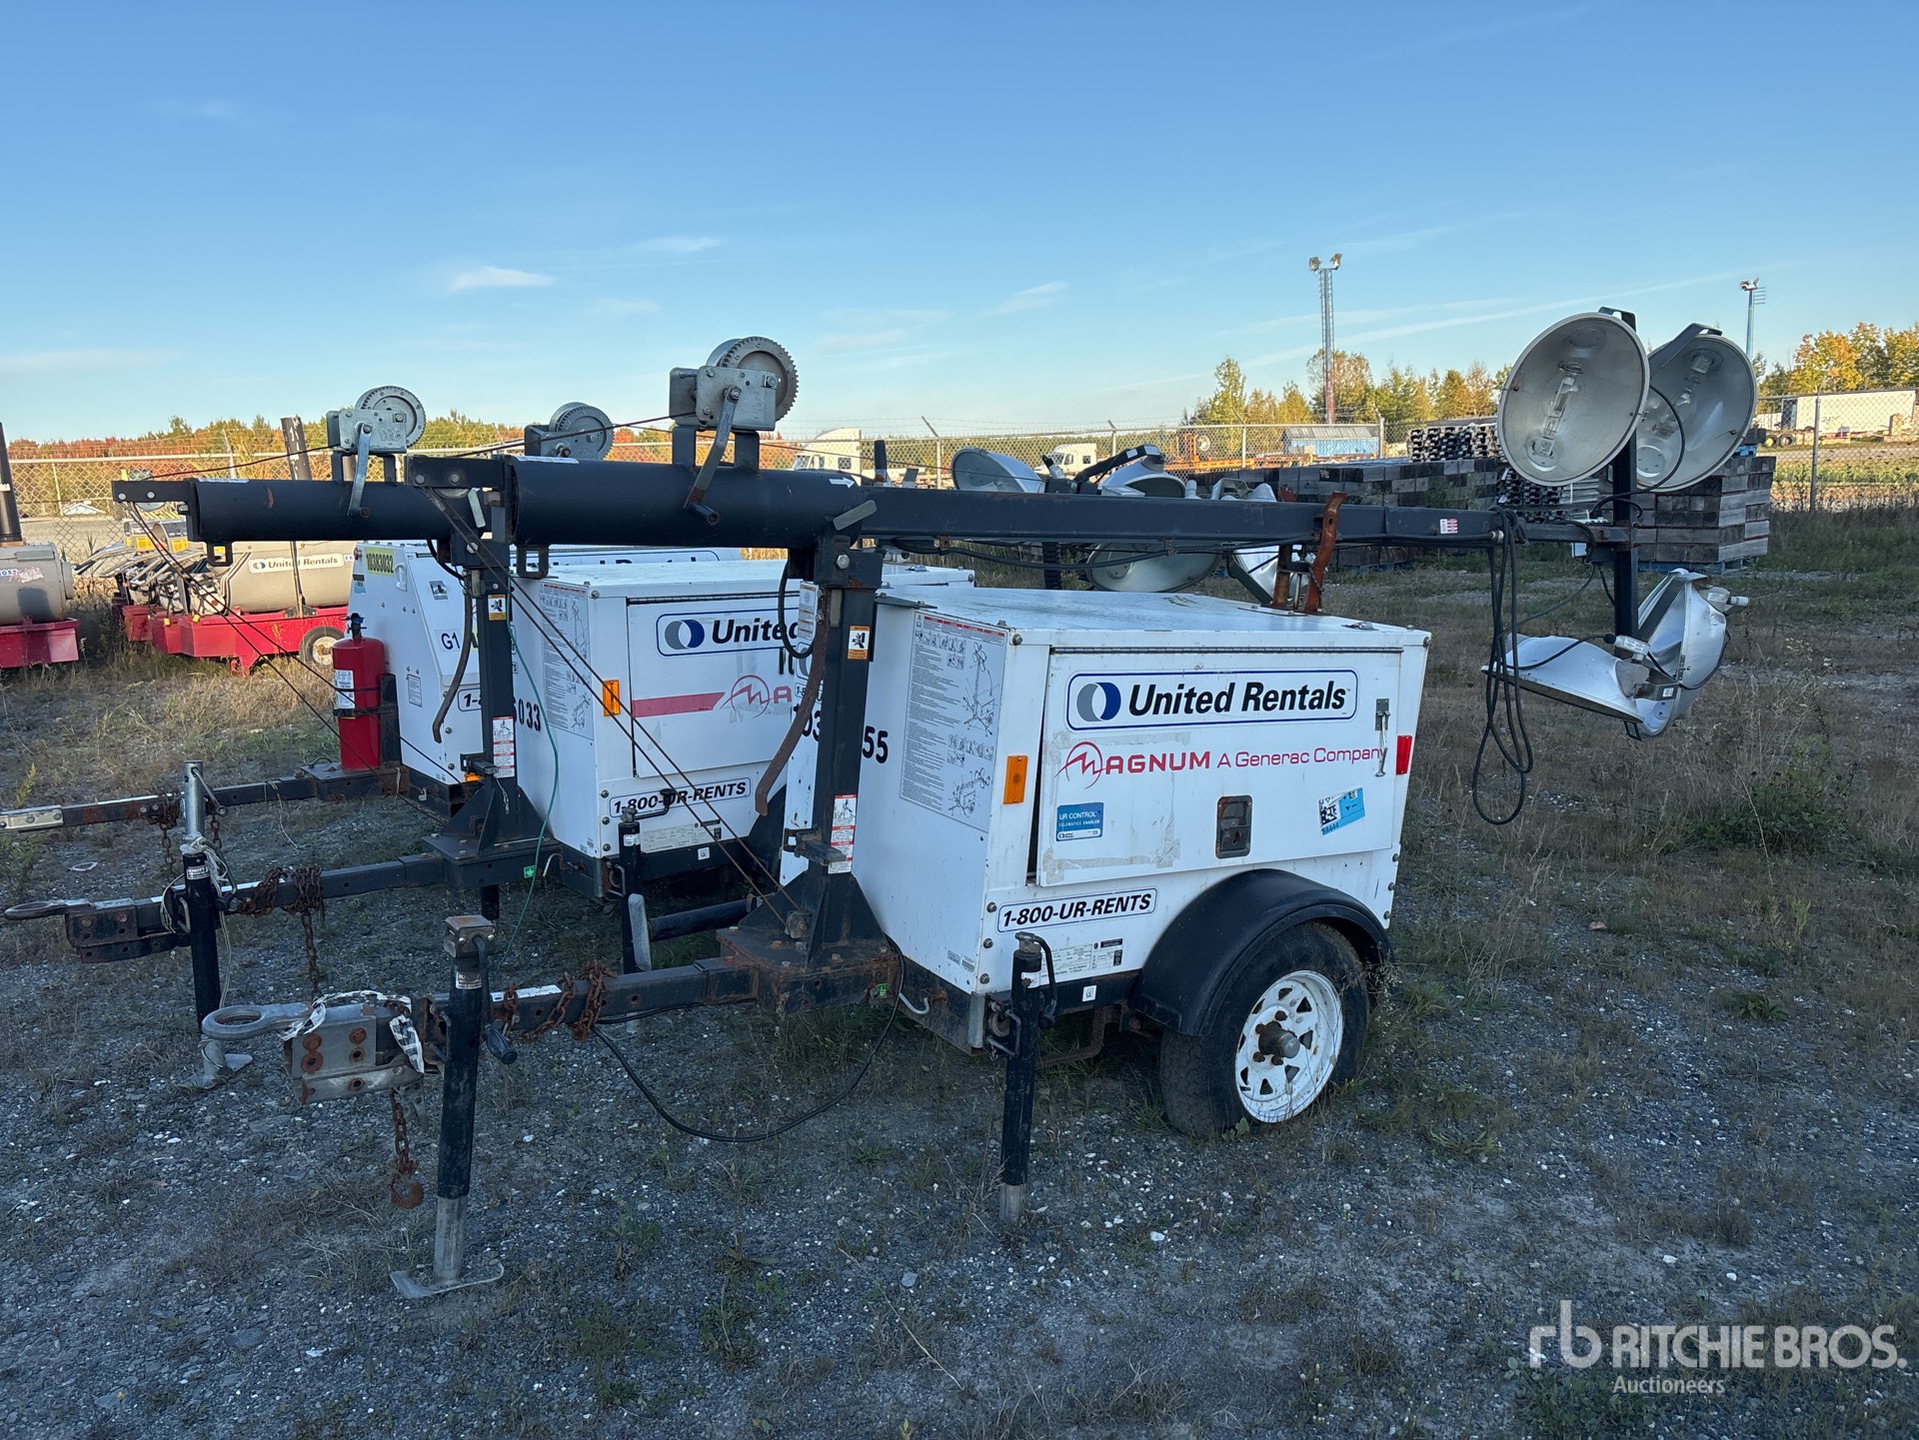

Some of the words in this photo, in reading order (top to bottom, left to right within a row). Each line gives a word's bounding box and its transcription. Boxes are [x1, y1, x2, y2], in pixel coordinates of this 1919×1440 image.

[303, 556, 337, 566] Rentals
[1129, 682, 1236, 716] United
[1241, 680, 1346, 712] Rentals
[1217, 753, 1231, 768] A
[1235, 751, 1310, 767] Generac
[1069, 810, 1096, 820] CONTROL
[1003, 893, 1152, 927] 1-800-UR-RENTS
